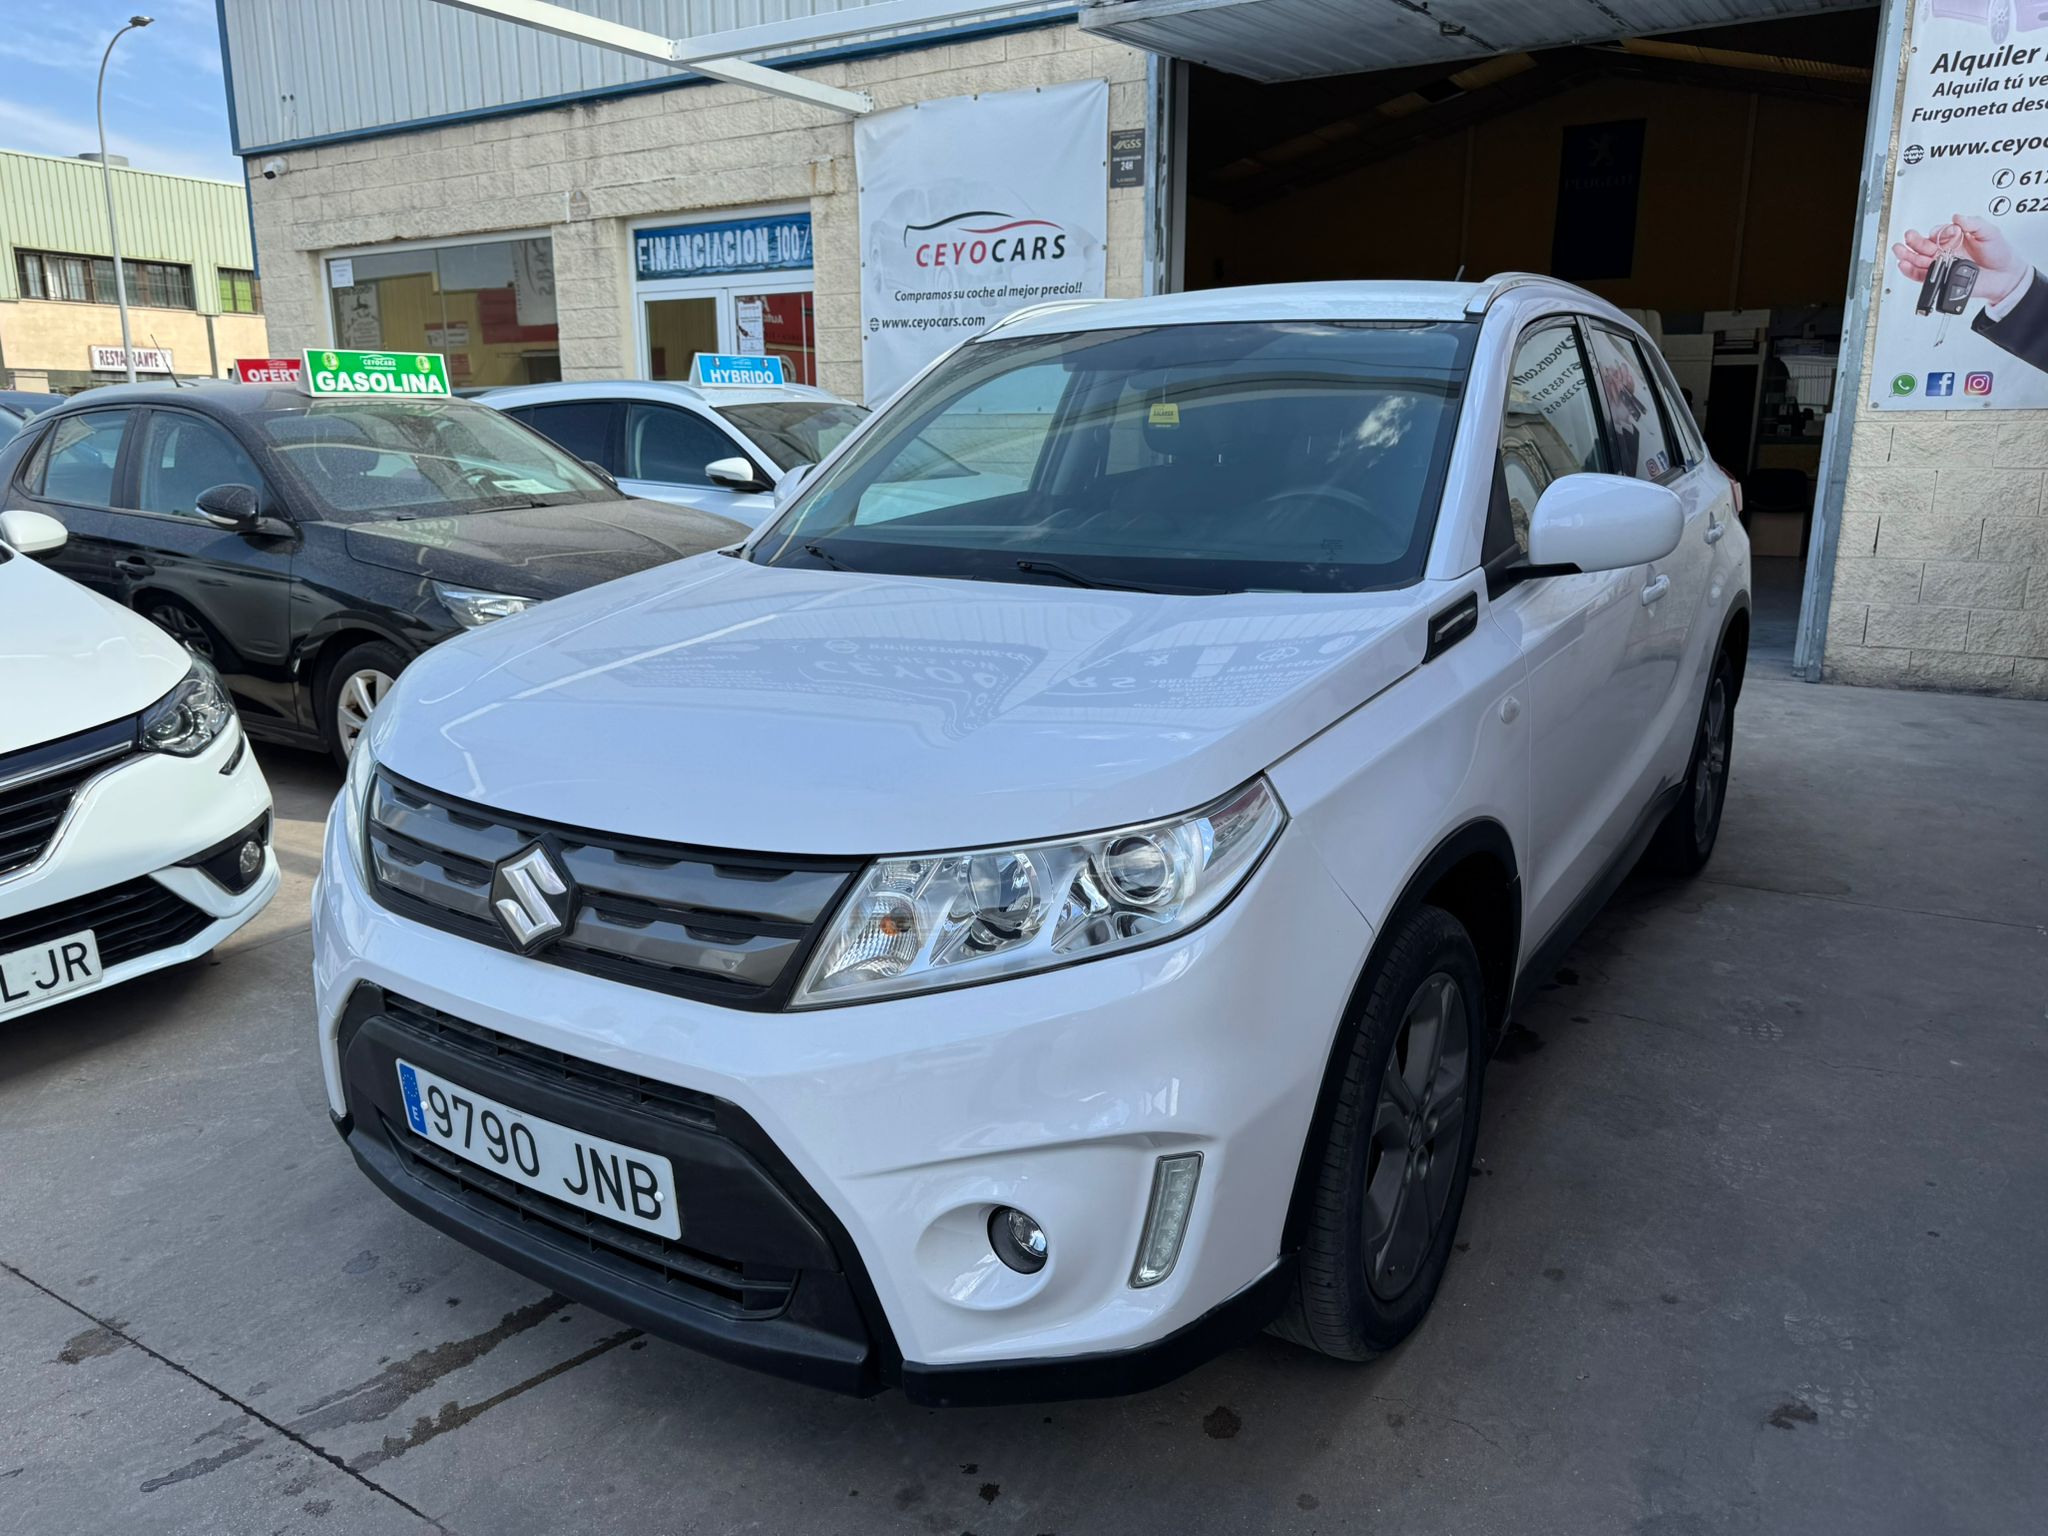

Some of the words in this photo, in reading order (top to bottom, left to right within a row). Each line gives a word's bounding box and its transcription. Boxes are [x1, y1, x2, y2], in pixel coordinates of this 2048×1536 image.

[1930, 44, 2041, 76] Alquiler
[1932, 77, 1999, 99] Alquila
[2004, 73, 2024, 90] tú
[1911, 101, 2008, 123] Furgoneta
[636, 227, 769, 271] FINANCIACION
[916, 234, 1066, 268] CEYOCARS
[895, 290, 952, 303] Compramos
[953, 290, 964, 299] su
[966, 286, 995, 298] coche
[997, 285, 1007, 297] al
[1009, 285, 1039, 299] mejor
[1041, 281, 1082, 299] precio!!
[882, 315, 985, 331] www.ceyocars.com
[98, 350, 159, 367] RESTARANTE
[316, 371, 444, 393] GASOLINA
[709, 369, 775, 384] HYBRIDO
[427, 1085, 540, 1178] 9790
[562, 1143, 662, 1221] JNB
